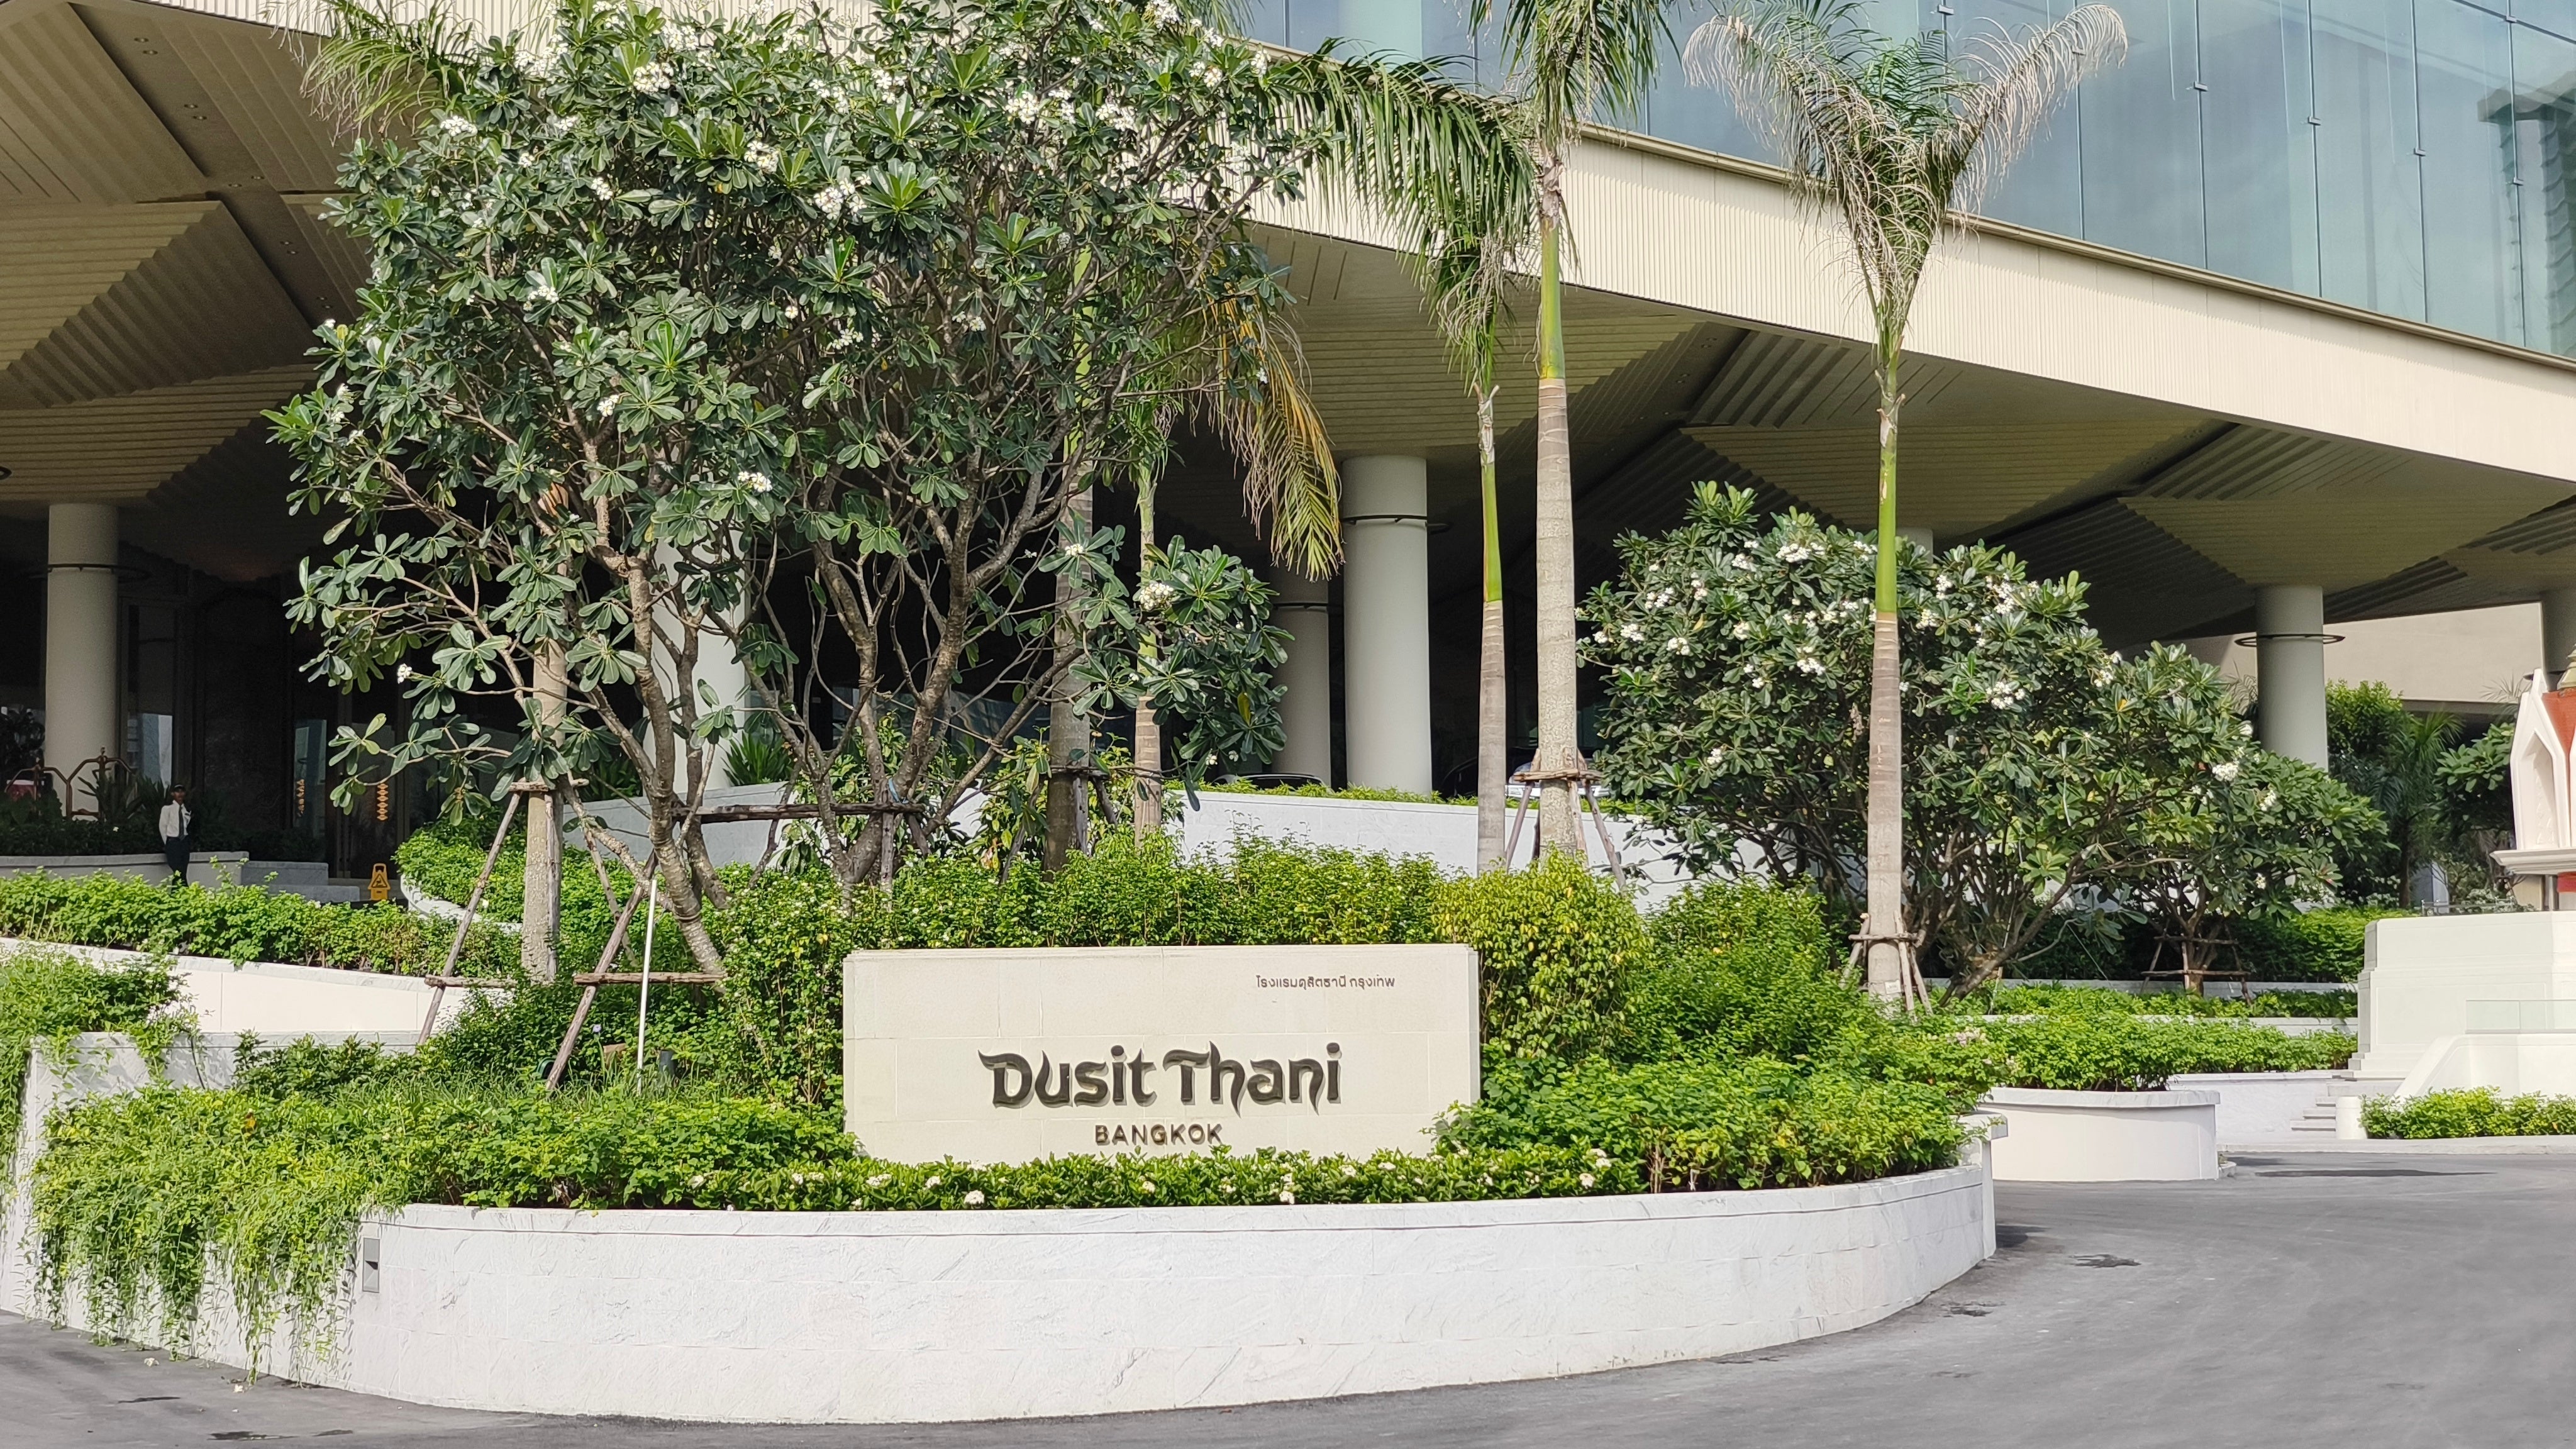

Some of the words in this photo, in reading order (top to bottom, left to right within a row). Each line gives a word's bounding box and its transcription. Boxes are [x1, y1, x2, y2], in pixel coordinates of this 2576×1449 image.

[978, 1045, 1157, 1109] Dusit
[1163, 1041, 1340, 1115] Thani
[1095, 1124, 1223, 1146] BANGKOK
